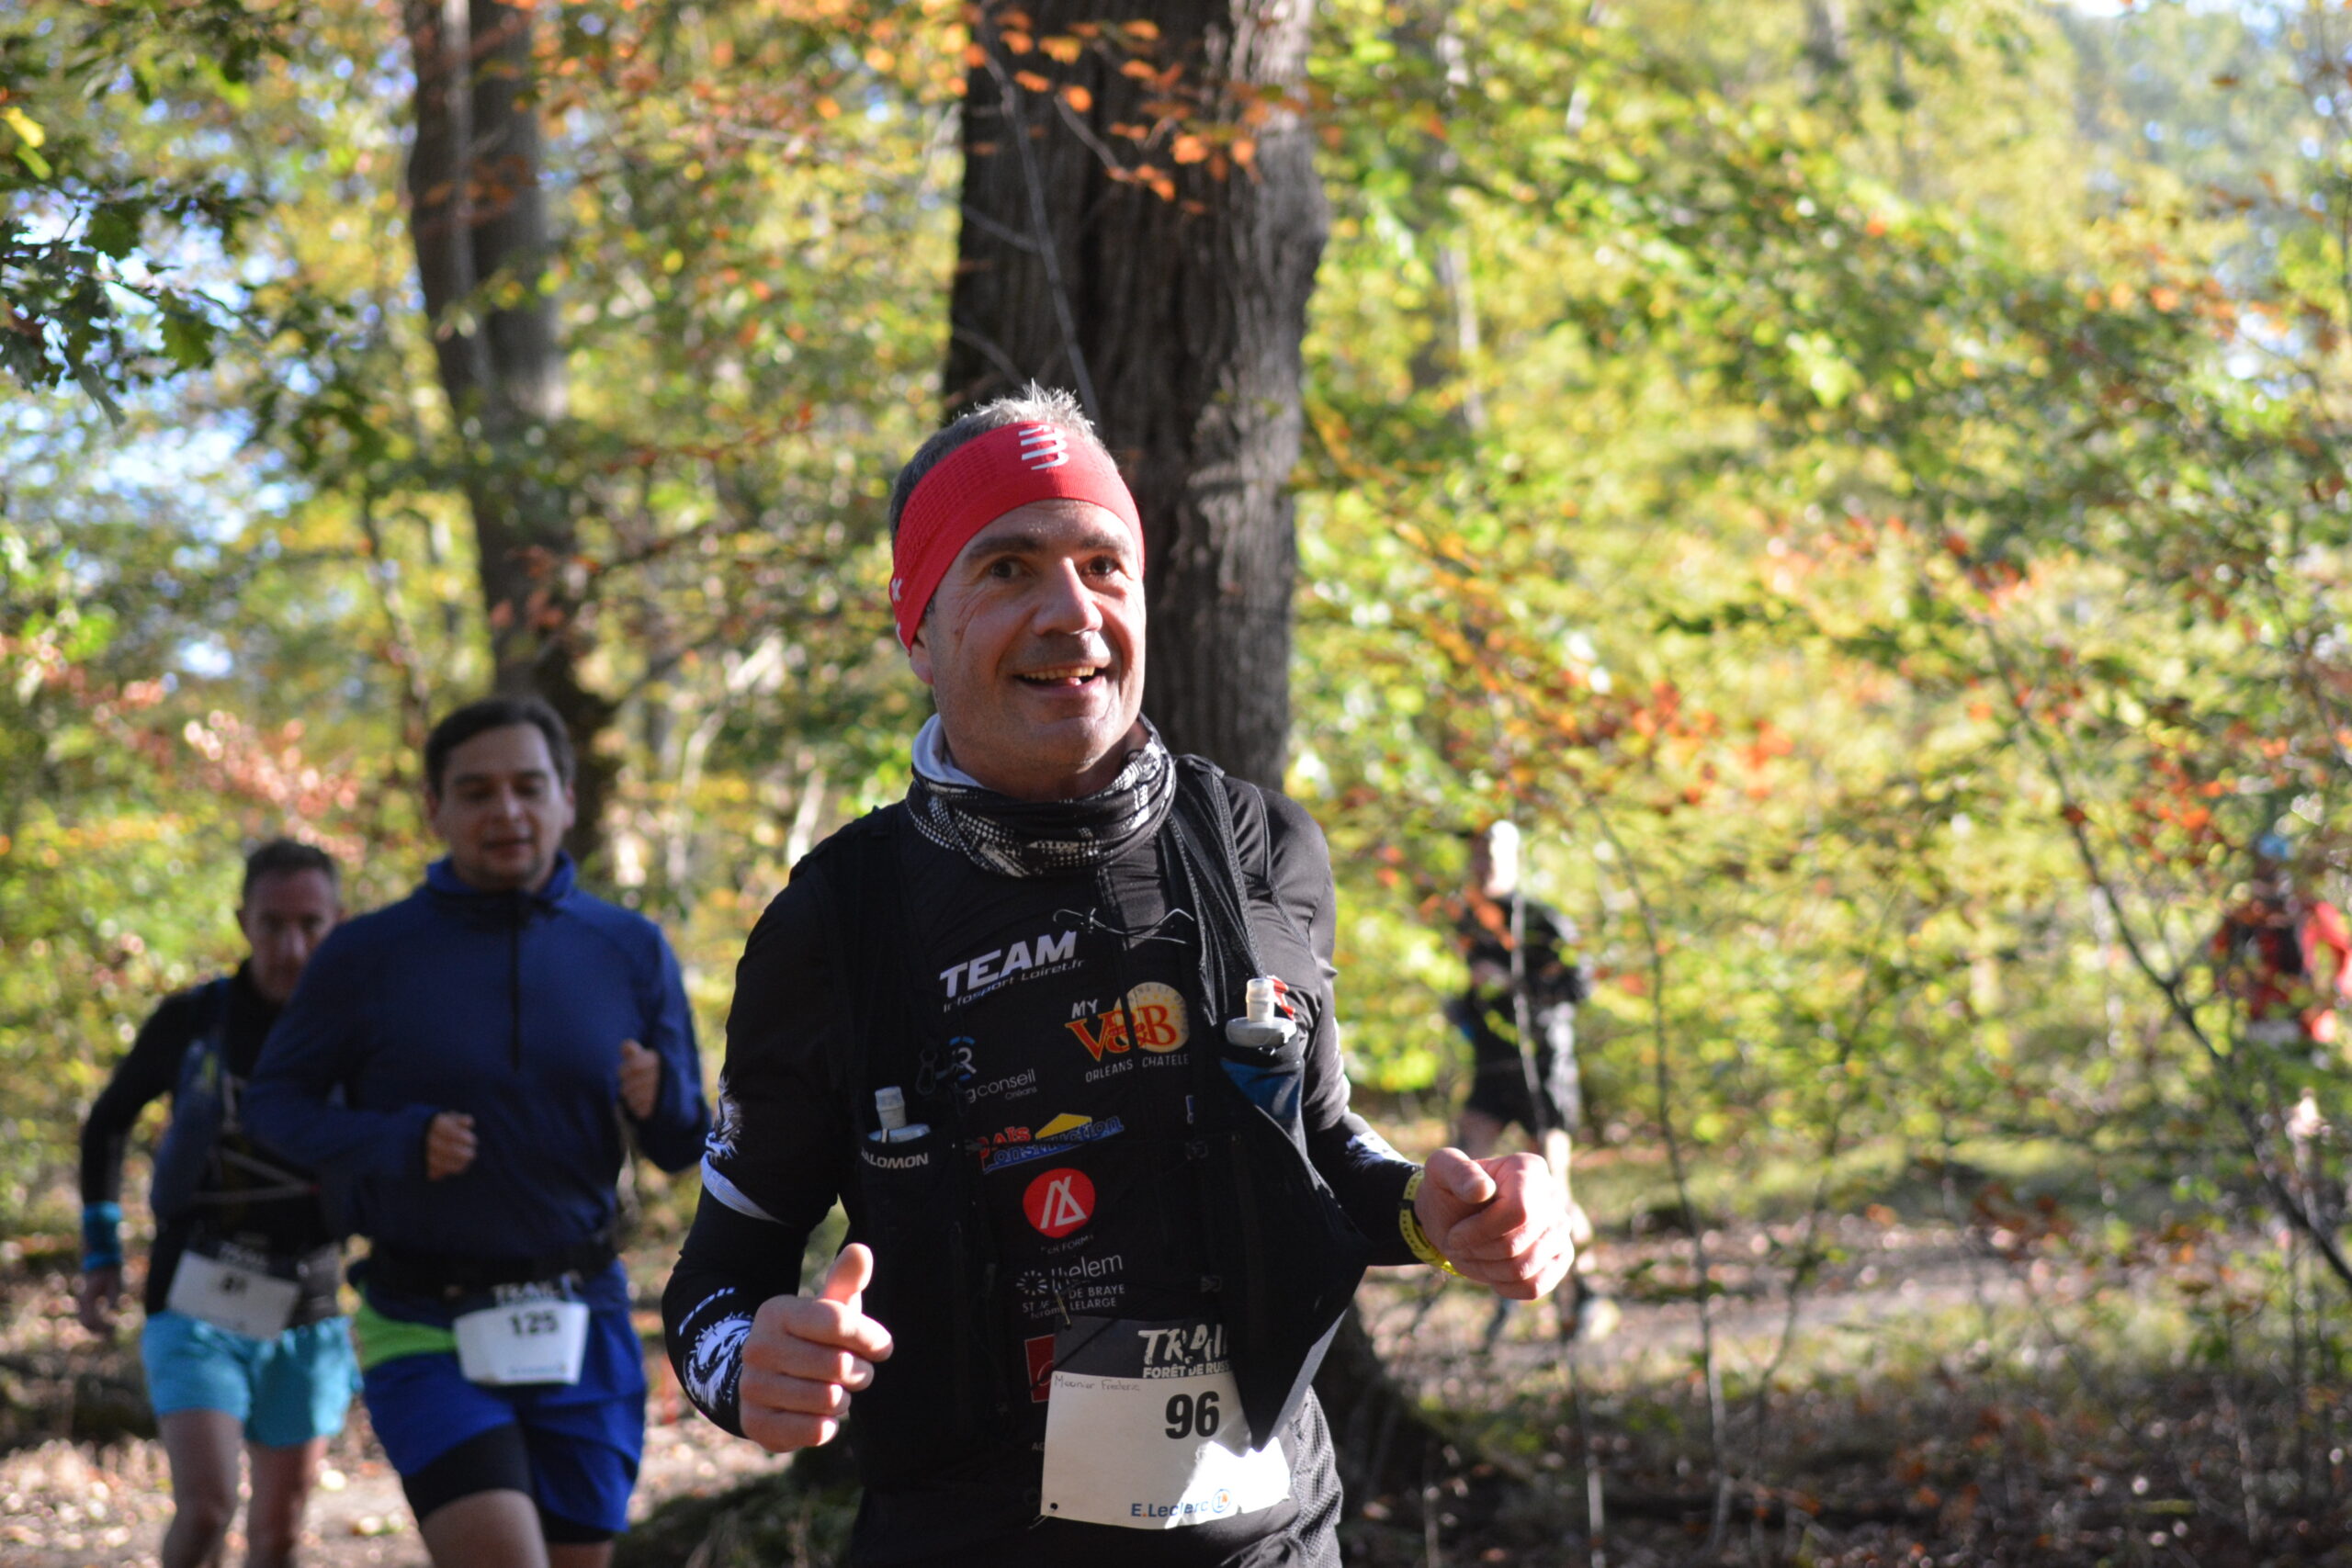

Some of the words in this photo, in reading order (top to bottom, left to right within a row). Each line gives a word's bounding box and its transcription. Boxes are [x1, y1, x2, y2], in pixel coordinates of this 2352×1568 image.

[939, 929, 1078, 998] TEAM
[1020, 958, 1086, 982] Loiret.fr
[1071, 998, 1098, 1019] MY
[1085, 1059, 1134, 1084] ORLEANS
[1142, 1053, 1191, 1068] CHATELE
[1069, 1287, 1083, 1300] DE
[1088, 1283, 1125, 1298] BRAYE
[1069, 1297, 1117, 1312] LELARGE
[510, 1311, 559, 1337] 125
[1142, 1363, 1186, 1379] FORÊT
[1205, 1359, 1231, 1375] RUSS
[1165, 1391, 1220, 1439] 96
[1130, 1500, 1209, 1517] E.Leclerc
